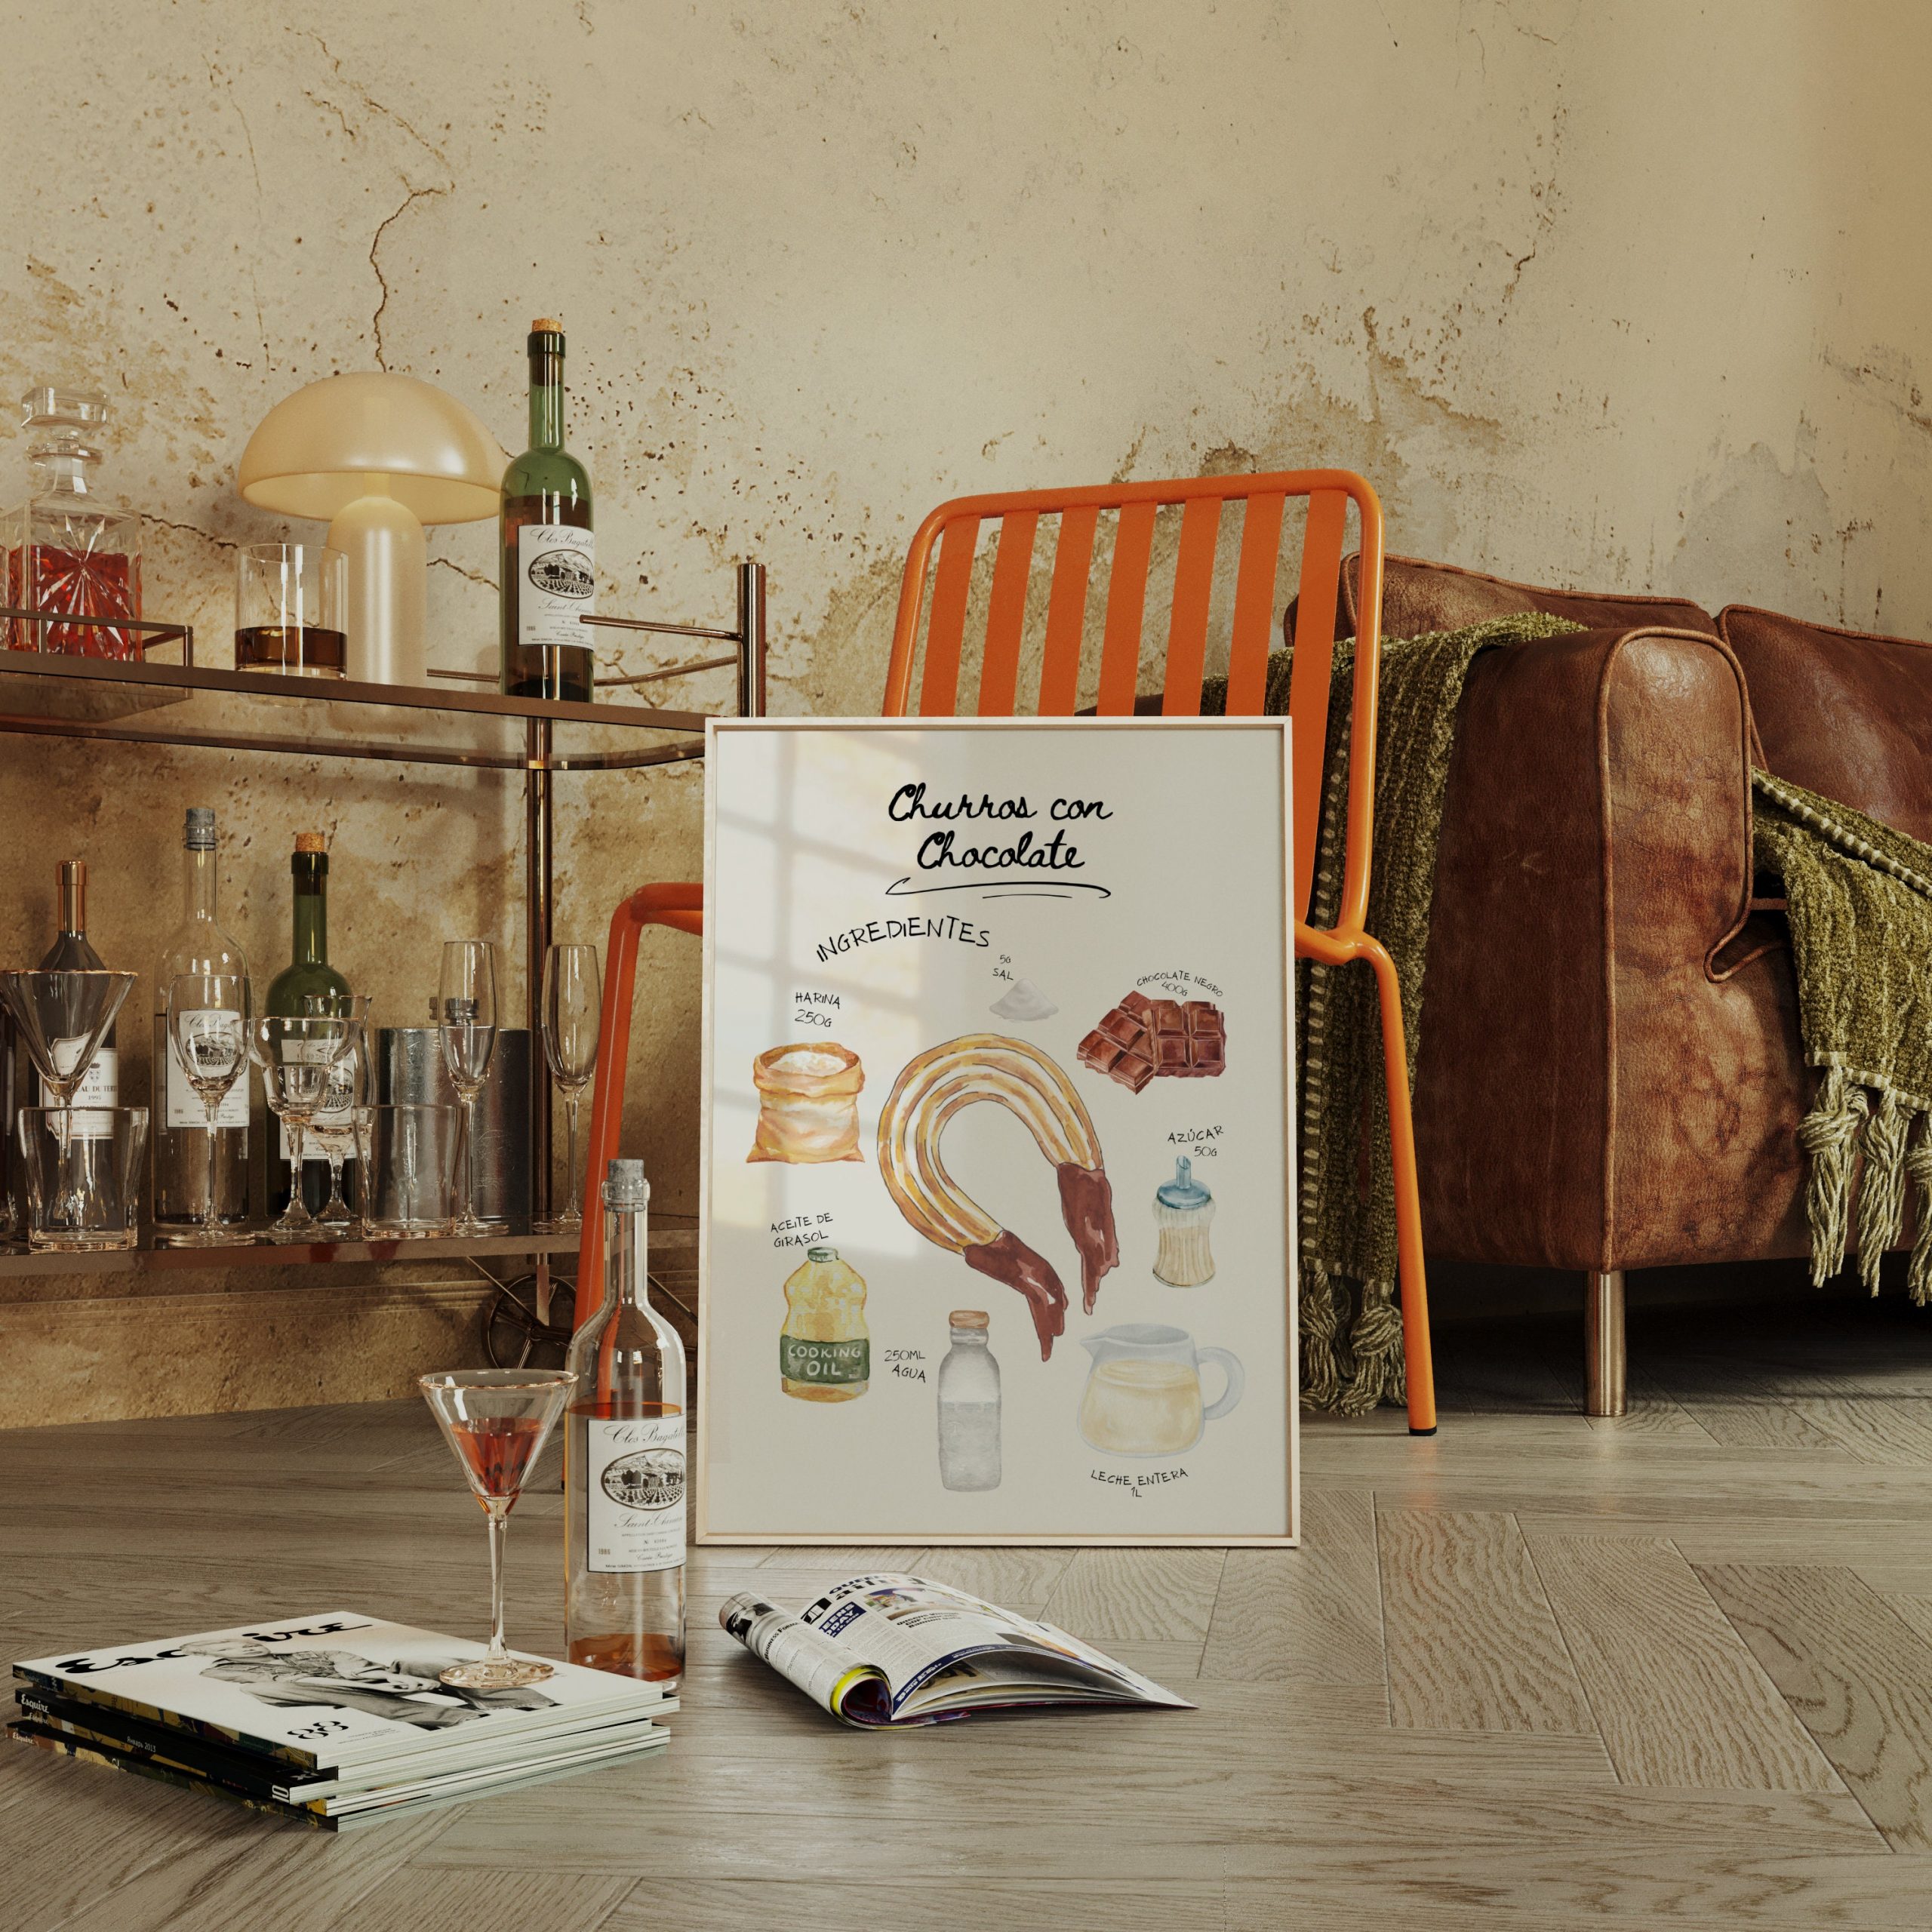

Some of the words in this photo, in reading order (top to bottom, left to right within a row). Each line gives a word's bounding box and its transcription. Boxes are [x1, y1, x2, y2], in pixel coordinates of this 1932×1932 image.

[888, 782, 1038, 821] Churros
[1050, 798, 1113, 820] con
[917, 829, 1085, 869] Chocolate
[816, 915, 990, 963] INGREDIENTES
[999, 954, 1012, 964] 5G
[992, 968, 1014, 981] SAL
[1137, 970, 1191, 986] CHOCOLATE
[1194, 975, 1223, 997] NEGRO
[1161, 982, 1189, 997] 400G
[795, 992, 840, 1010] HARINA
[794, 1008, 832, 1028] 250G
[1167, 1124, 1224, 1144] AZÚCAR
[1194, 1146, 1217, 1158] 50G
[771, 1217, 812, 1233] ACEITE
[817, 1213, 834, 1224] DE
[774, 1230, 829, 1247] GIRASOL
[788, 1344, 861, 1358] COOKING
[884, 1349, 926, 1362] 250ML
[806, 1361, 841, 1376] OIL
[892, 1364, 926, 1383] AGUA
[603, 1424, 638, 1444] Clos
[1091, 1469, 1132, 1485] LECHE
[1137, 1468, 1189, 1485] ENTERA
[1131, 1487, 1143, 1498] 1L
[21, 1694, 49, 1714] Esquire
[12, 1732, 35, 1745] Esquire
[127, 1737, 144, 1749] Январь
[144, 1741, 156, 1752] 2013
